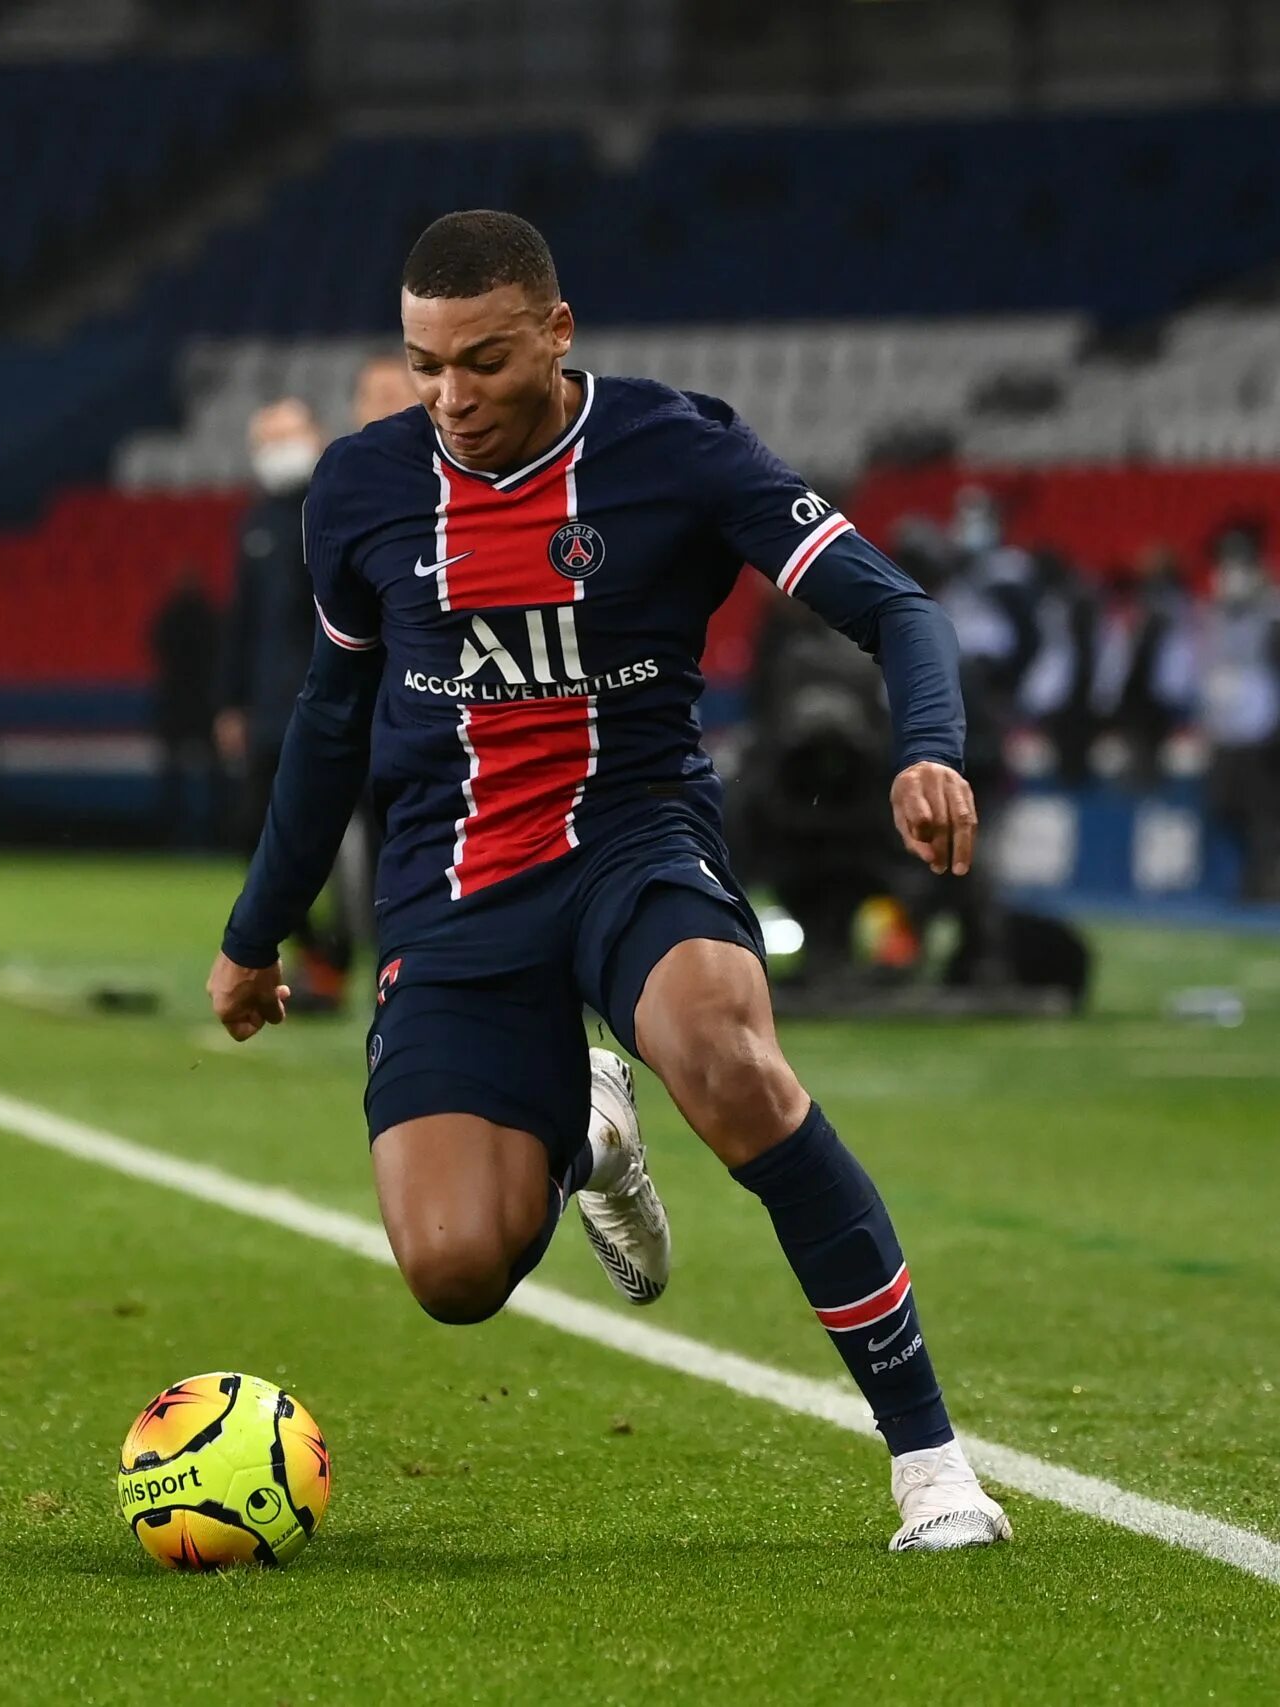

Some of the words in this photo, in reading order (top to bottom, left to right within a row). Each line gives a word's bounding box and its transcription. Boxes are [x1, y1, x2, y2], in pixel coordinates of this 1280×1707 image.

[557, 526, 594, 541] PARIS
[404, 668, 476, 699] ACCOR
[482, 682, 536, 700] LIVE
[870, 1333, 923, 1375] PARIS
